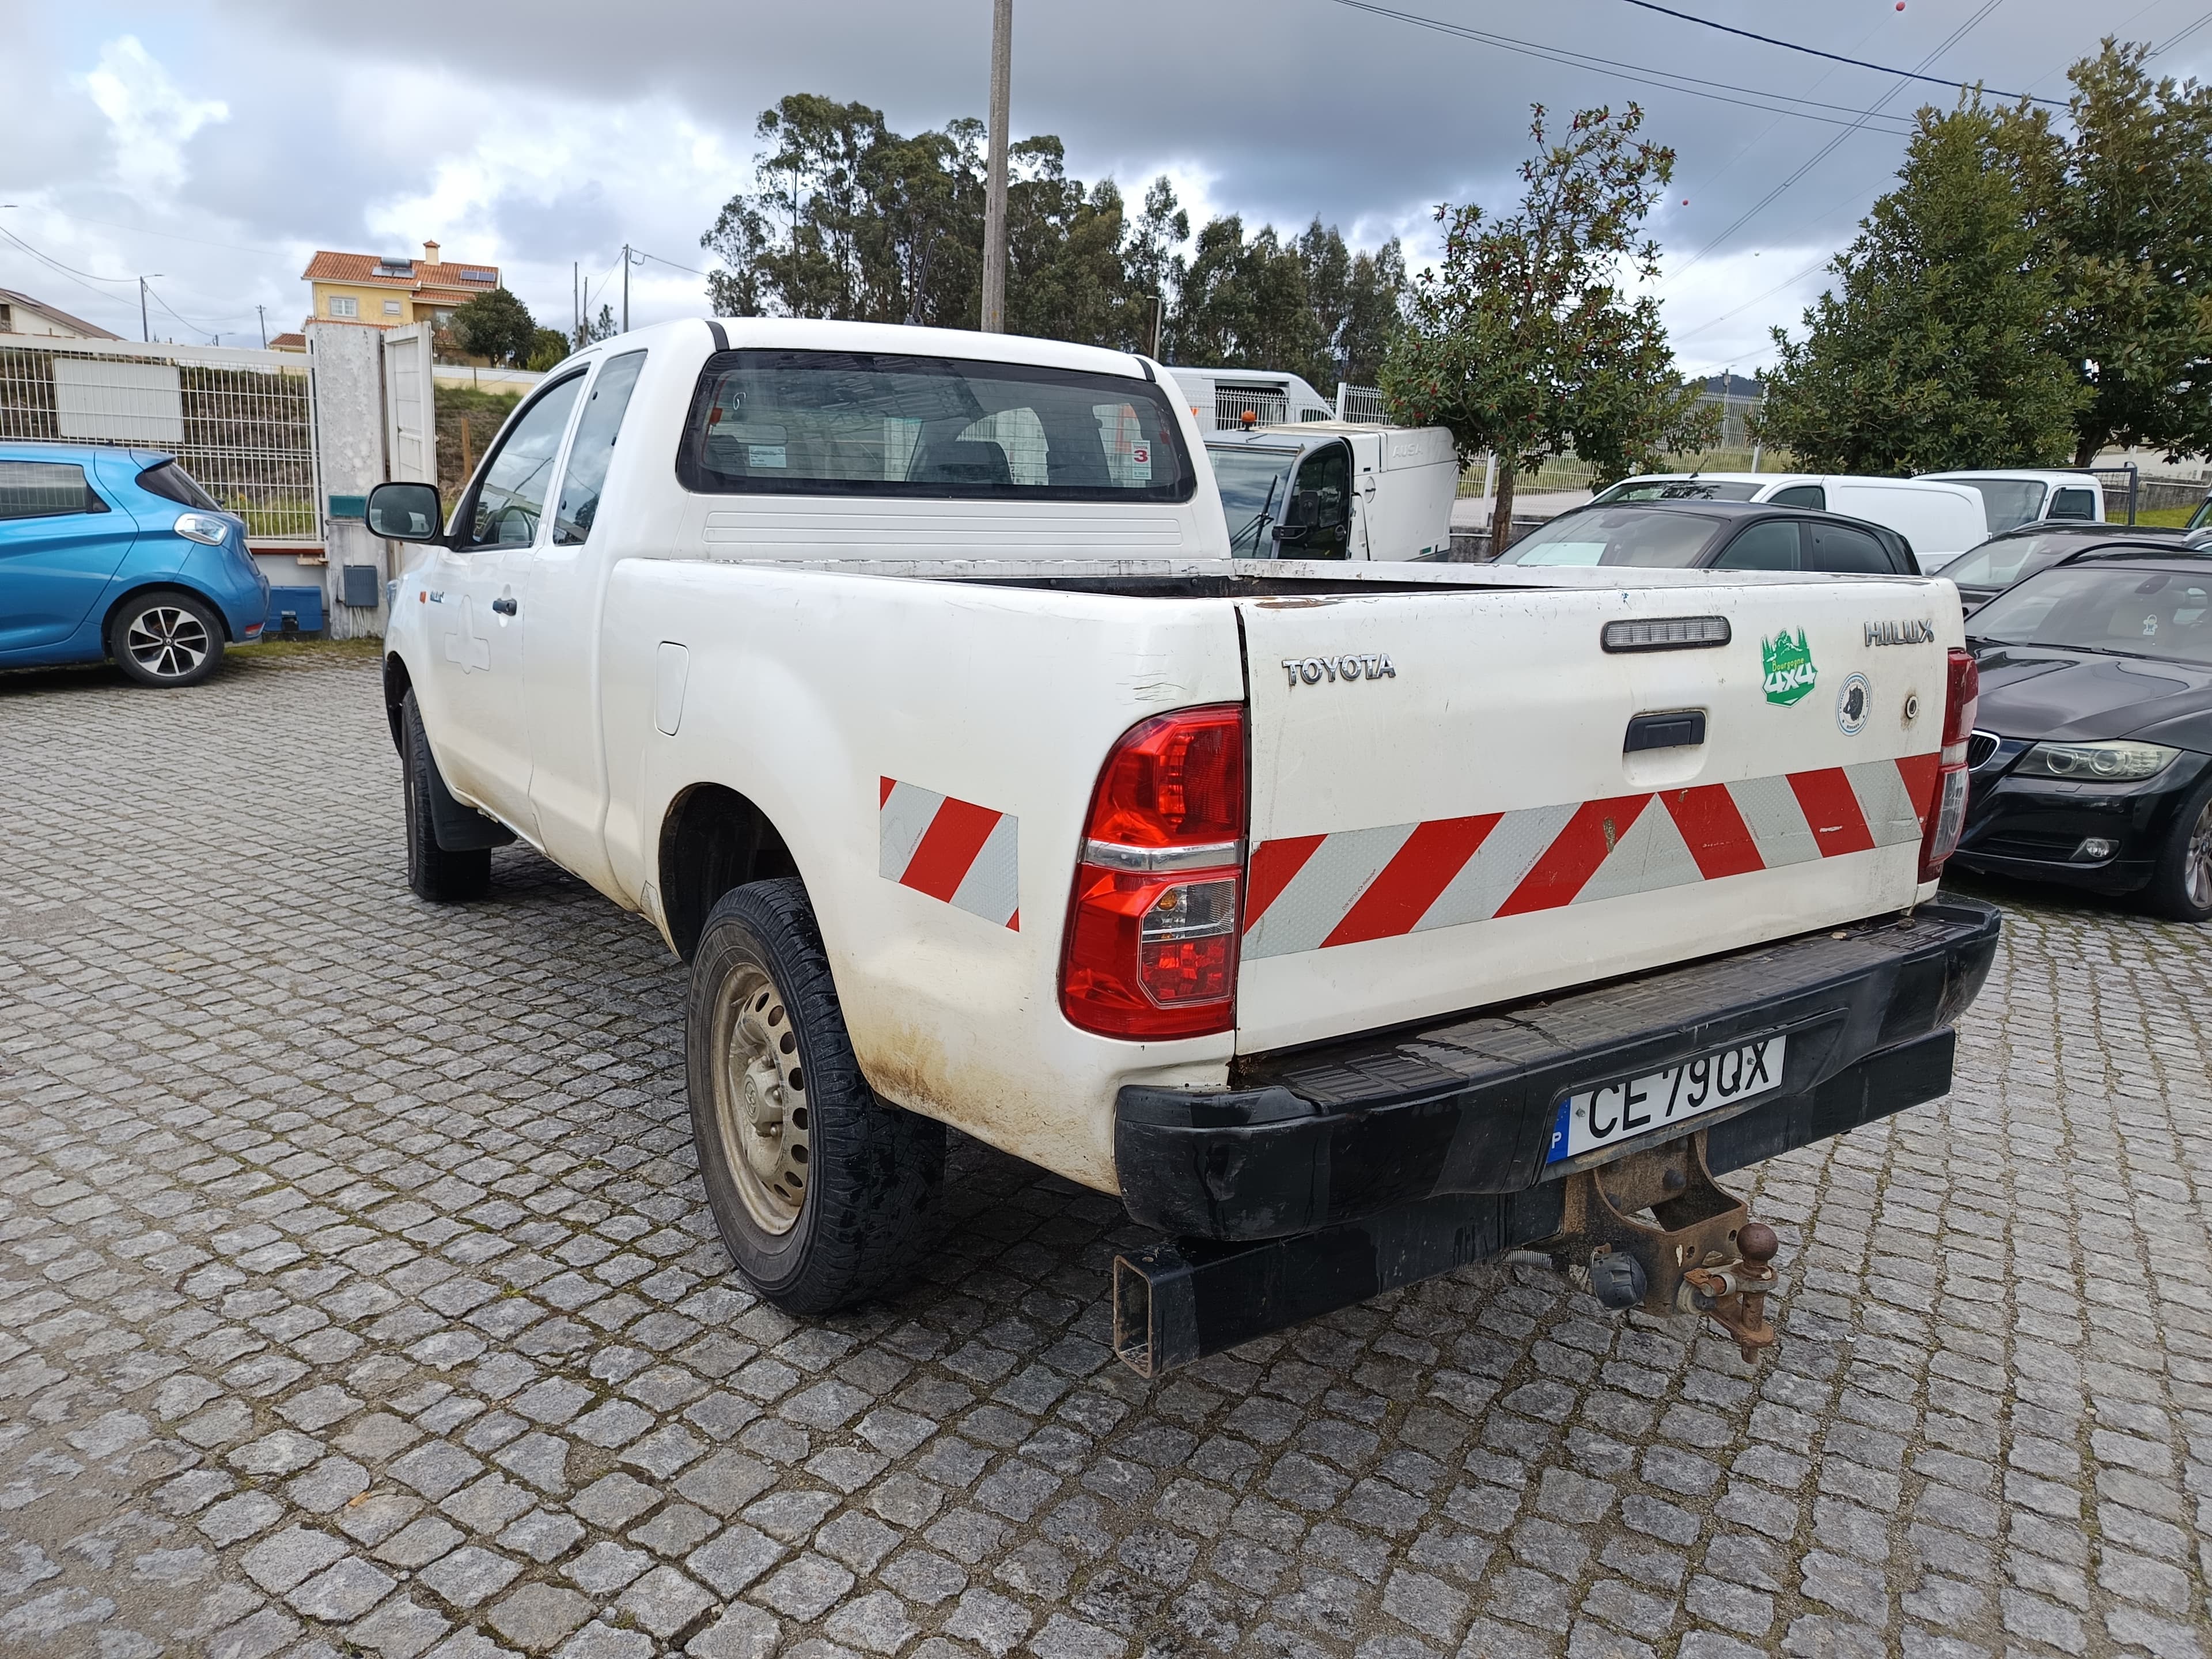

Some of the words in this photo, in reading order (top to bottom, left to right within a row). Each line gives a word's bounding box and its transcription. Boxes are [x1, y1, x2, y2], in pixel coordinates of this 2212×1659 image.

[1134, 450, 1148, 463] 3
[1392, 443, 1423, 459] AUSA
[1864, 619, 1934, 646] HILUX
[1282, 653, 1396, 686] TOYOTA
[1772, 658, 1804, 672] Bourgogne
[1589, 1080, 1651, 1138] CE
[1662, 1057, 1710, 1117] 79
[1717, 1041, 1770, 1097] QX
[1551, 1132, 1562, 1149] P
